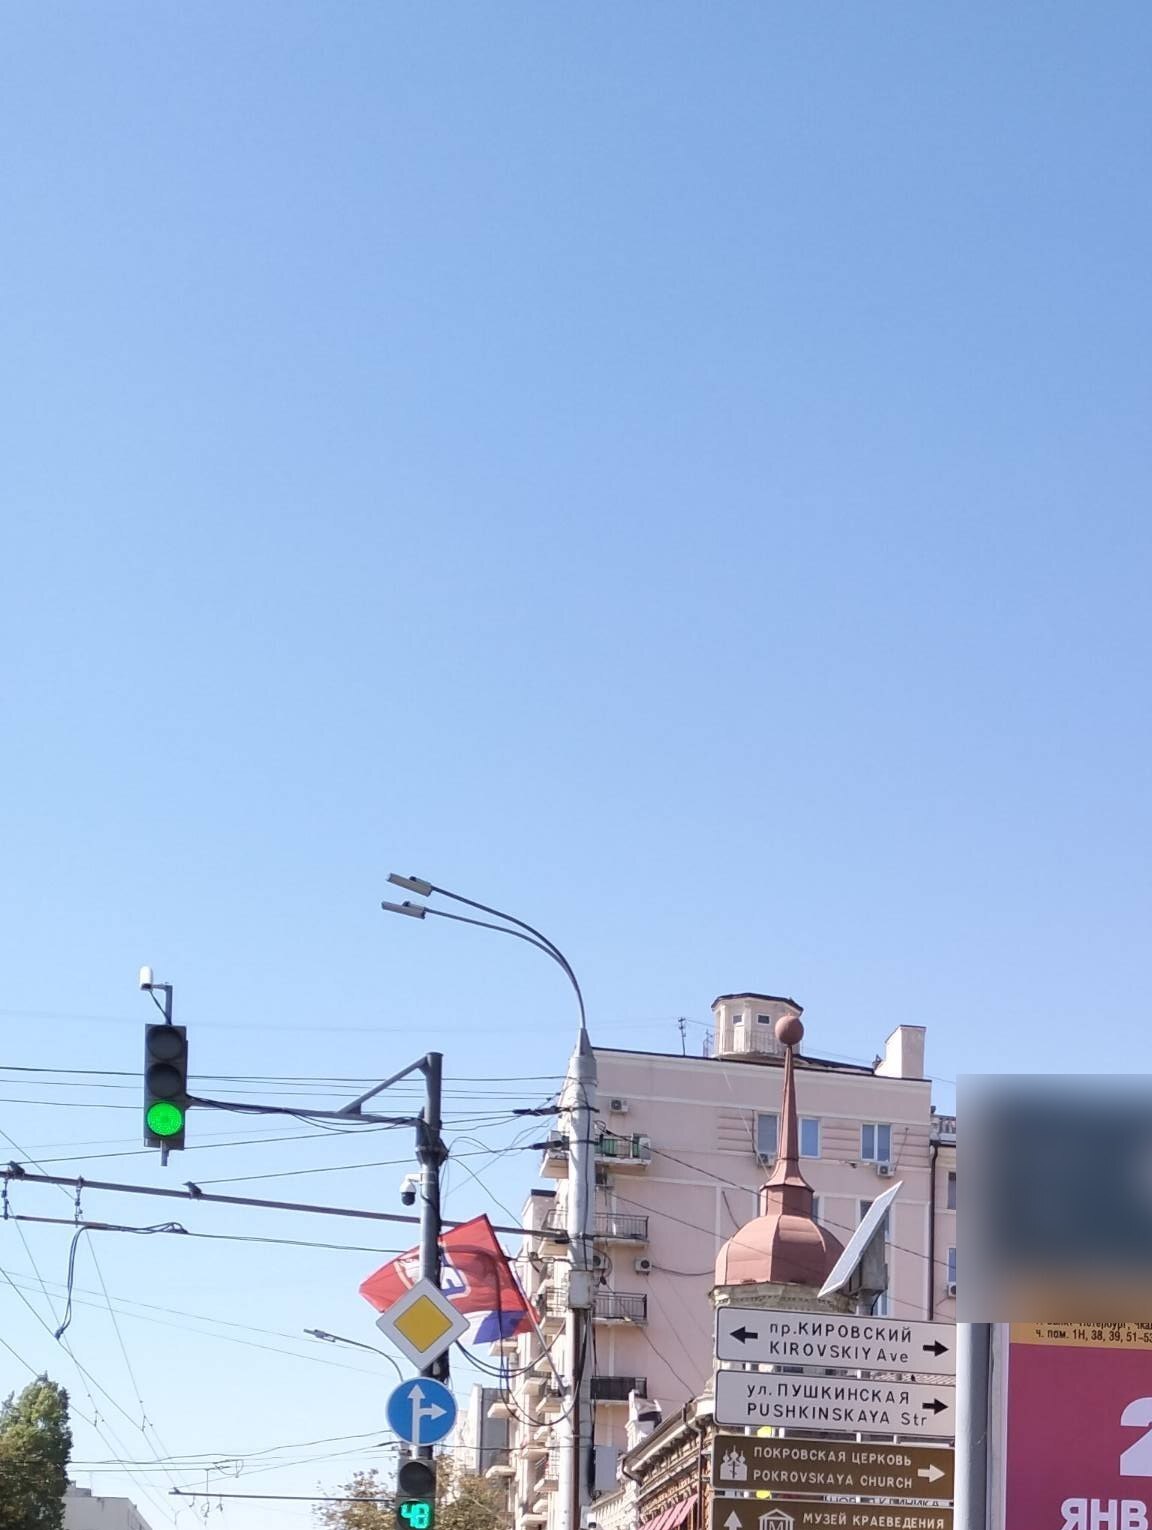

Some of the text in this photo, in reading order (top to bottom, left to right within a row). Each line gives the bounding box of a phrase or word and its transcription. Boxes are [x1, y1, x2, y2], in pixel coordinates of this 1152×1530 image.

[1091, 1330, 1106, 1342] 38,
[1109, 1331, 1123, 1343] 39,
[770, 1341, 909, 1363] KIROVSKIY Ave
[747, 1383, 909, 1404] ул. ПУШКИНСКАЯ
[747, 1402, 928, 1426] PUSHKINSKAYA Str
[753, 1446, 912, 1467] ПОКРОВСКАЯ ЦЕРКОВЬ
[753, 1470, 912, 1489] POKROVSKAYA CHURCH
[400, 1503, 430, 1529] 48
[802, 1511, 944, 1530] МУЗЕЙ КРАЕВЕДЕНИЯ
